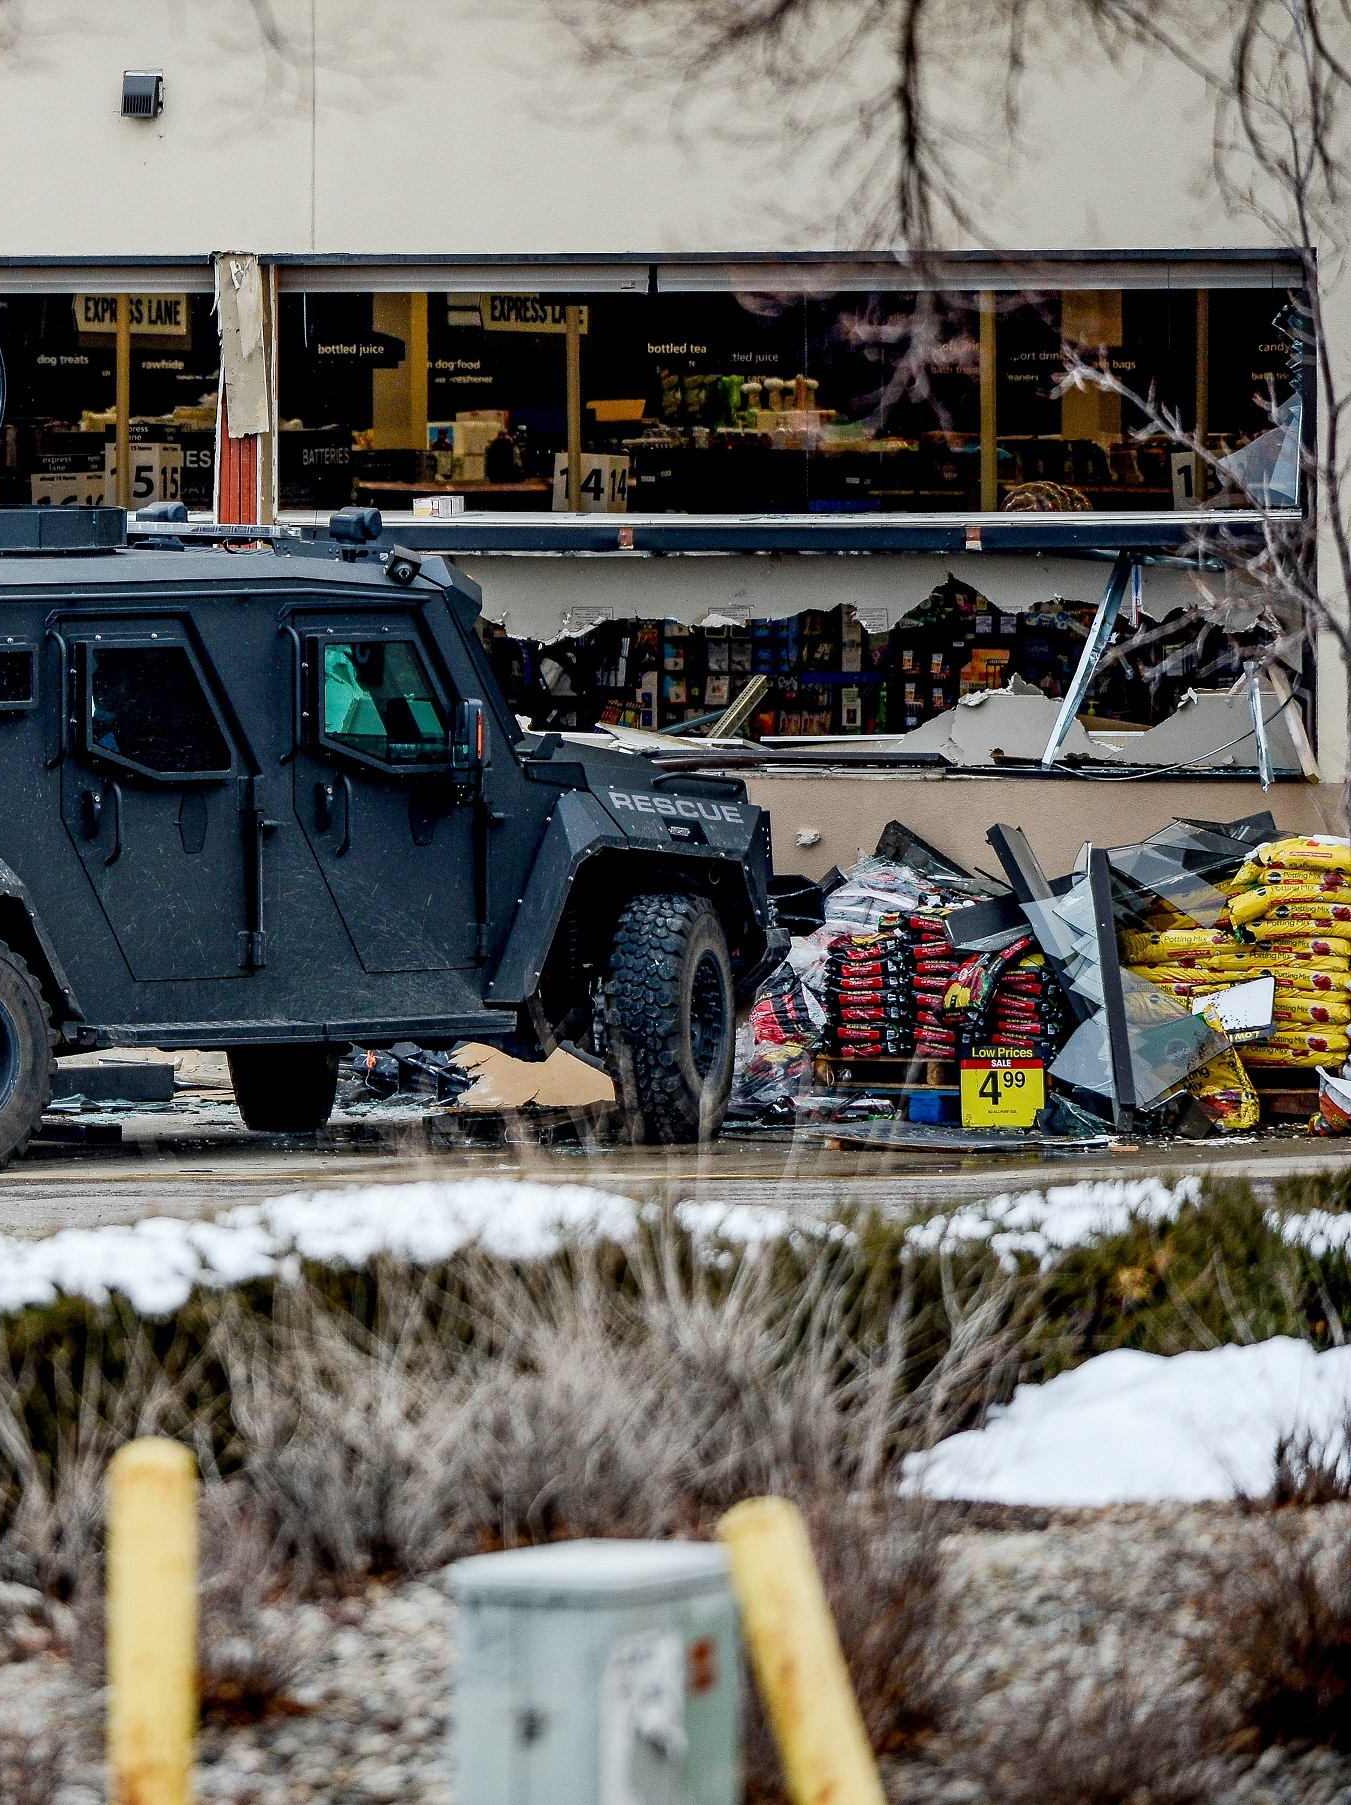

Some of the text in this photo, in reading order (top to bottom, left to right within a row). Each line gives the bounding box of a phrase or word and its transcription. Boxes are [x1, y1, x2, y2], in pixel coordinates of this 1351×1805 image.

[84, 296, 181, 326] EXPRSS LANE
[491, 295, 548, 324] EXPRESS
[317, 343, 385, 356] bottled juice
[648, 342, 707, 355] bottled tea
[1258, 341, 1290, 354] candy
[37, 354, 89, 367] dog treats
[755, 352, 779, 364] juice
[435, 358, 482, 372] dog food
[1112, 360, 1137, 371] bags
[42, 456, 72, 465] express
[302, 447, 350, 466] BATTERIES
[161, 466, 179, 500] 15
[610, 468, 627, 502] 14
[607, 791, 744, 824] RESCUE
[971, 1047, 1033, 1058] Low Prices
[991, 1059, 1012, 1067] SALE
[1183, 1081, 1205, 1094] Mix
